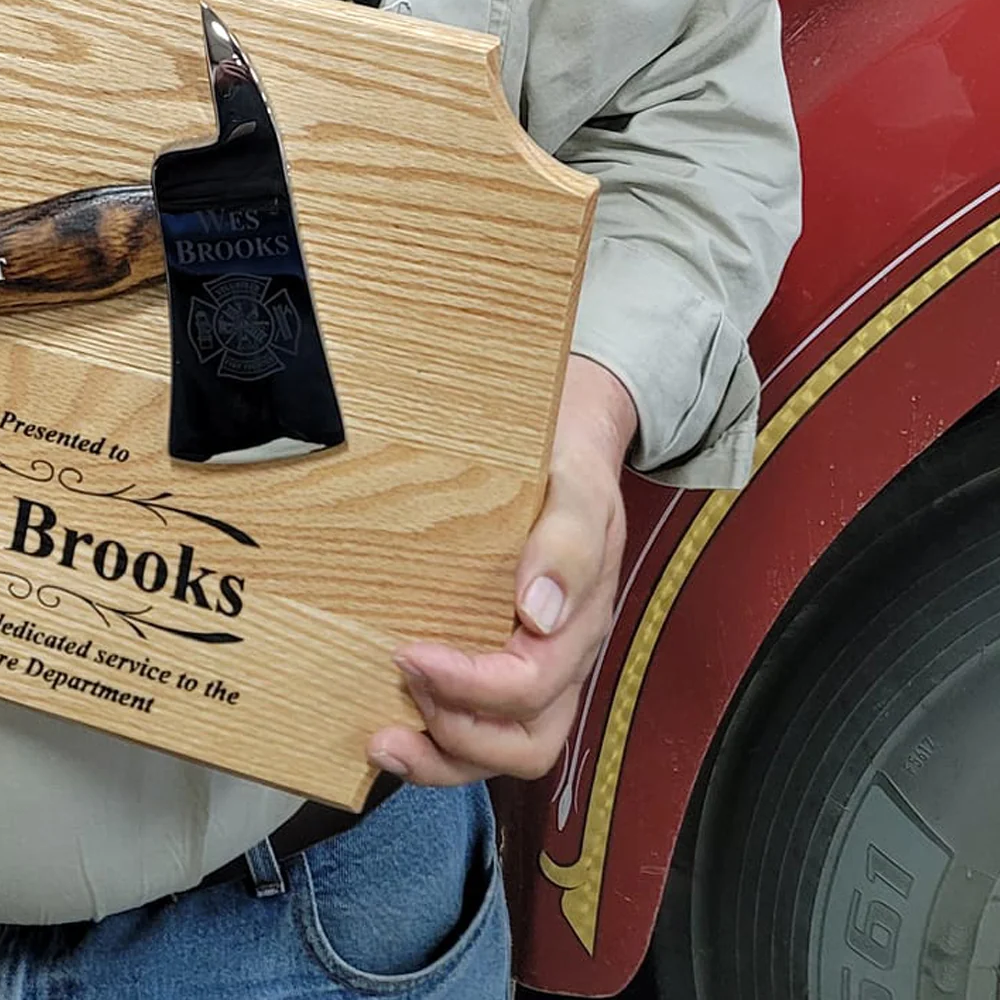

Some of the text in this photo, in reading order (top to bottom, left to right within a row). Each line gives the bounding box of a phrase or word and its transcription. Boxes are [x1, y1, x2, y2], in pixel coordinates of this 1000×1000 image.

[201, 208, 260, 233] WES
[175, 235, 290, 265] BROOKS
[111, 443, 131, 464] to
[4, 496, 246, 618] Brooks
[23, 656, 156, 714] Department
[93, 647, 172, 684] service
[175, 672, 199, 692] to
[203, 679, 241, 706] the
